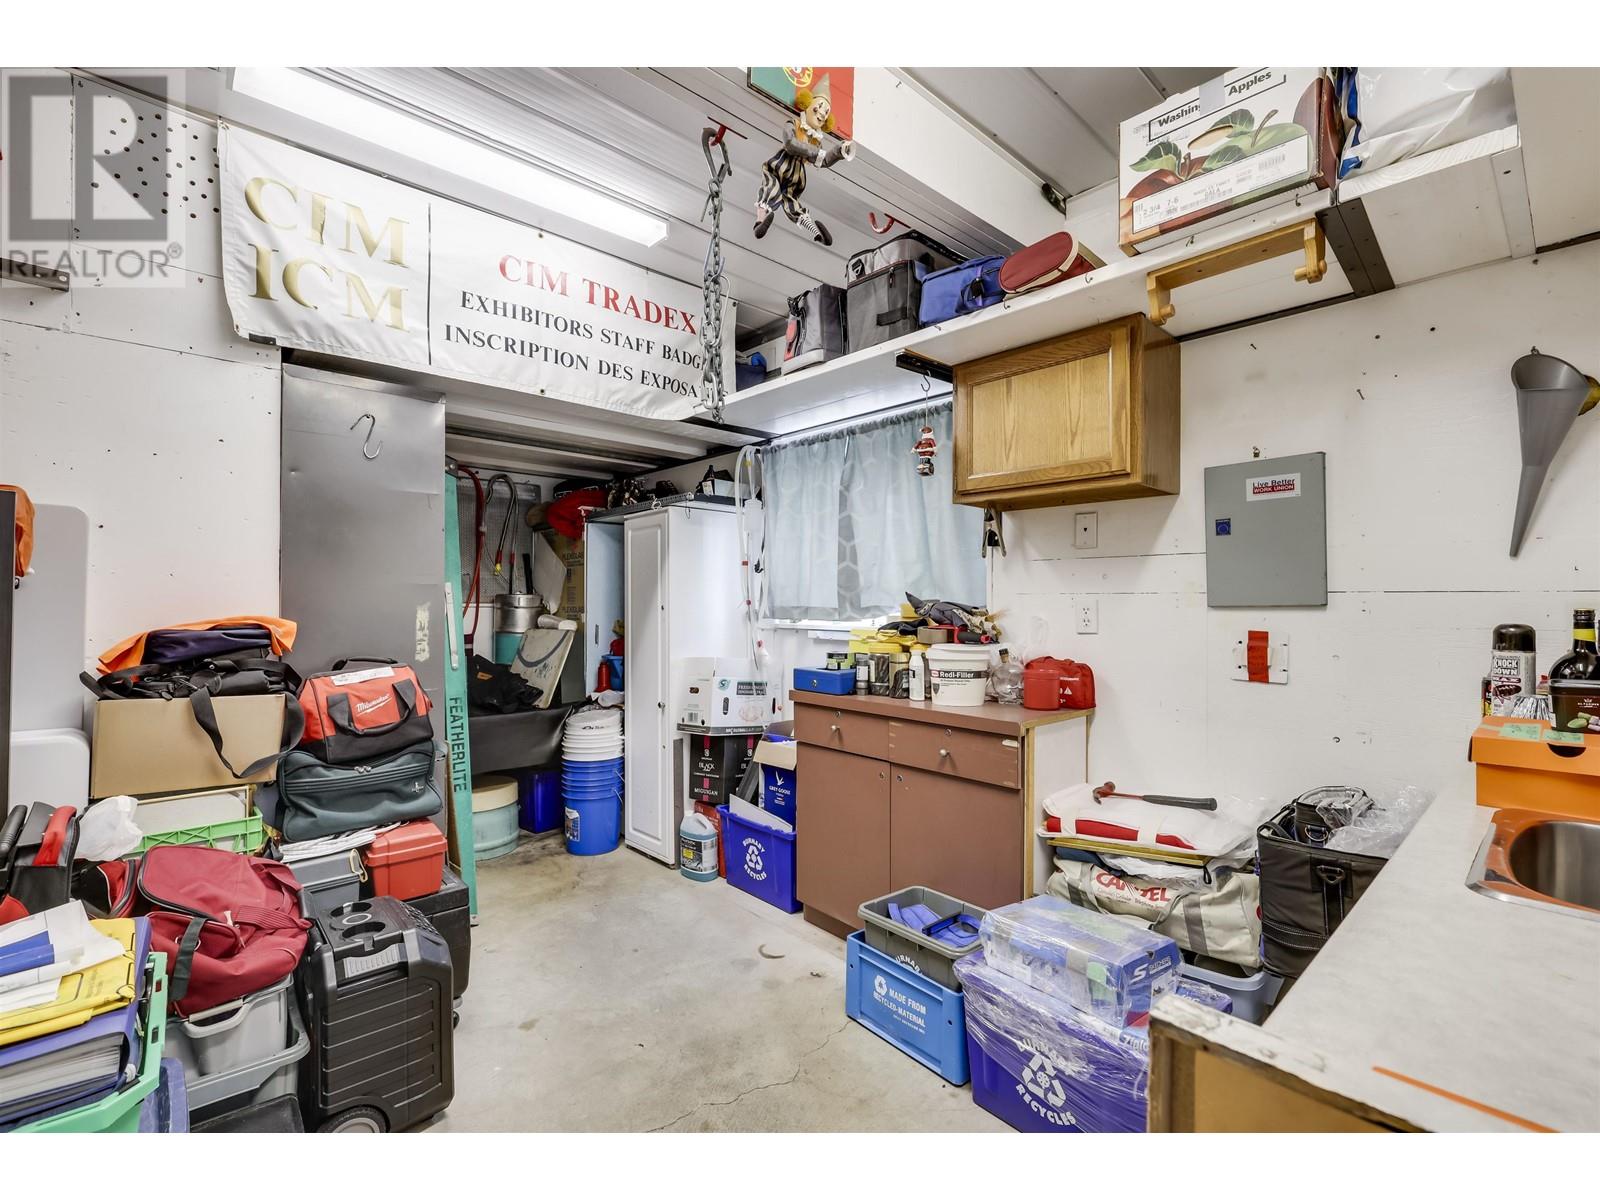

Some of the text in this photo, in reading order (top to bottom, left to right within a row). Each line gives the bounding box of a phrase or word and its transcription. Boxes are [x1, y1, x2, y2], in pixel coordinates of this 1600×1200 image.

[1228, 71, 1272, 96] Apples
[1157, 104, 1200, 127] Washin
[244, 176, 410, 269] CIM
[248, 243, 409, 333] ICM
[498, 254, 697, 336] CIM TRADEX
[460, 290, 594, 339] EXHIBITORS
[600, 327, 655, 356] STAFF
[444, 323, 590, 371] INSCRIPTION
[598, 359, 633, 382] DES
[1271, 478, 1295, 486] Better
[1493, 657, 1519, 669] KNOCK
[449, 697, 467, 793] FEATHERLITE
[888, 987, 927, 1015] MADE FROM
[1015, 1083, 1077, 1126] RECYCLES
